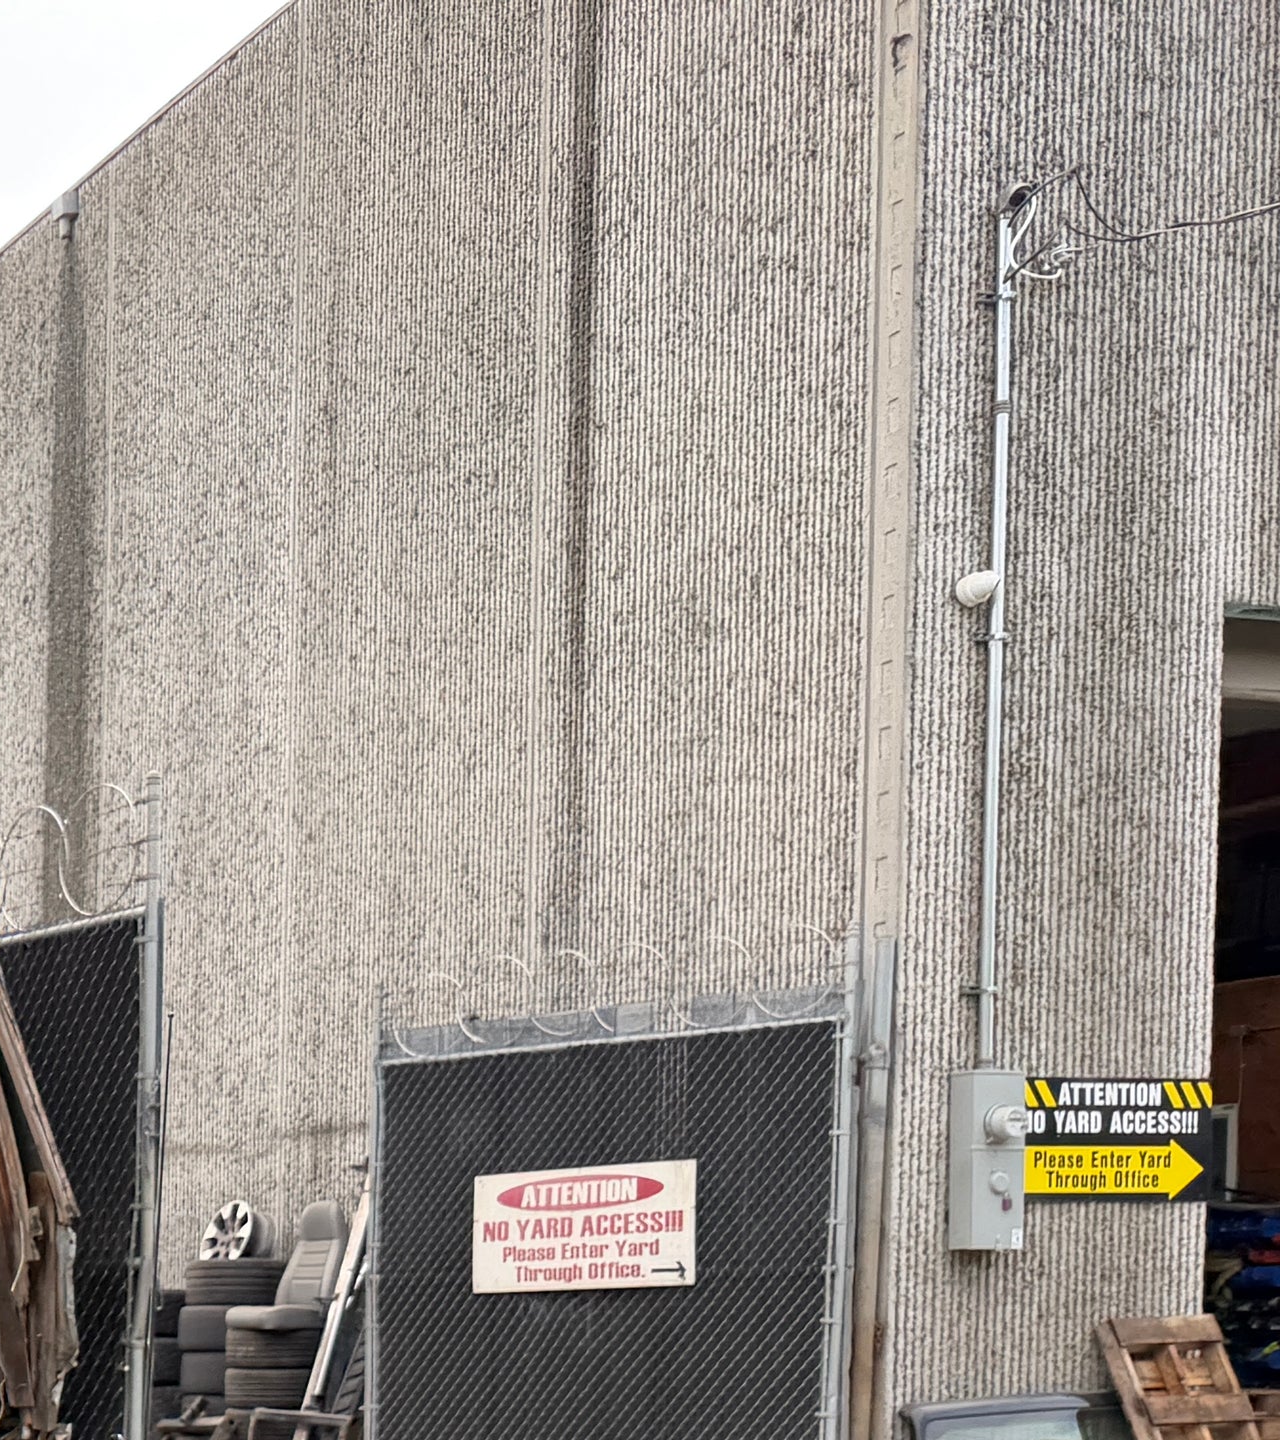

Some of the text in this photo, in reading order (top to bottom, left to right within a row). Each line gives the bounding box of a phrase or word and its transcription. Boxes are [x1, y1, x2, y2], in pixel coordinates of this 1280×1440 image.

[1058, 1081, 1162, 1107] ATTENTION
[1053, 1109, 1102, 1134] YARD
[1109, 1110, 1199, 1135] ACCESS!!!
[1033, 1151, 1172, 1169] Please Enter Yard
[520, 1176, 639, 1209] ATTENTION
[1045, 1170, 1160, 1191] Through Office
[482, 1209, 684, 1242] NO YARD ACCESS!!!
[502, 1238, 660, 1263] Please Enter Yard
[514, 1263, 583, 1284] Through
